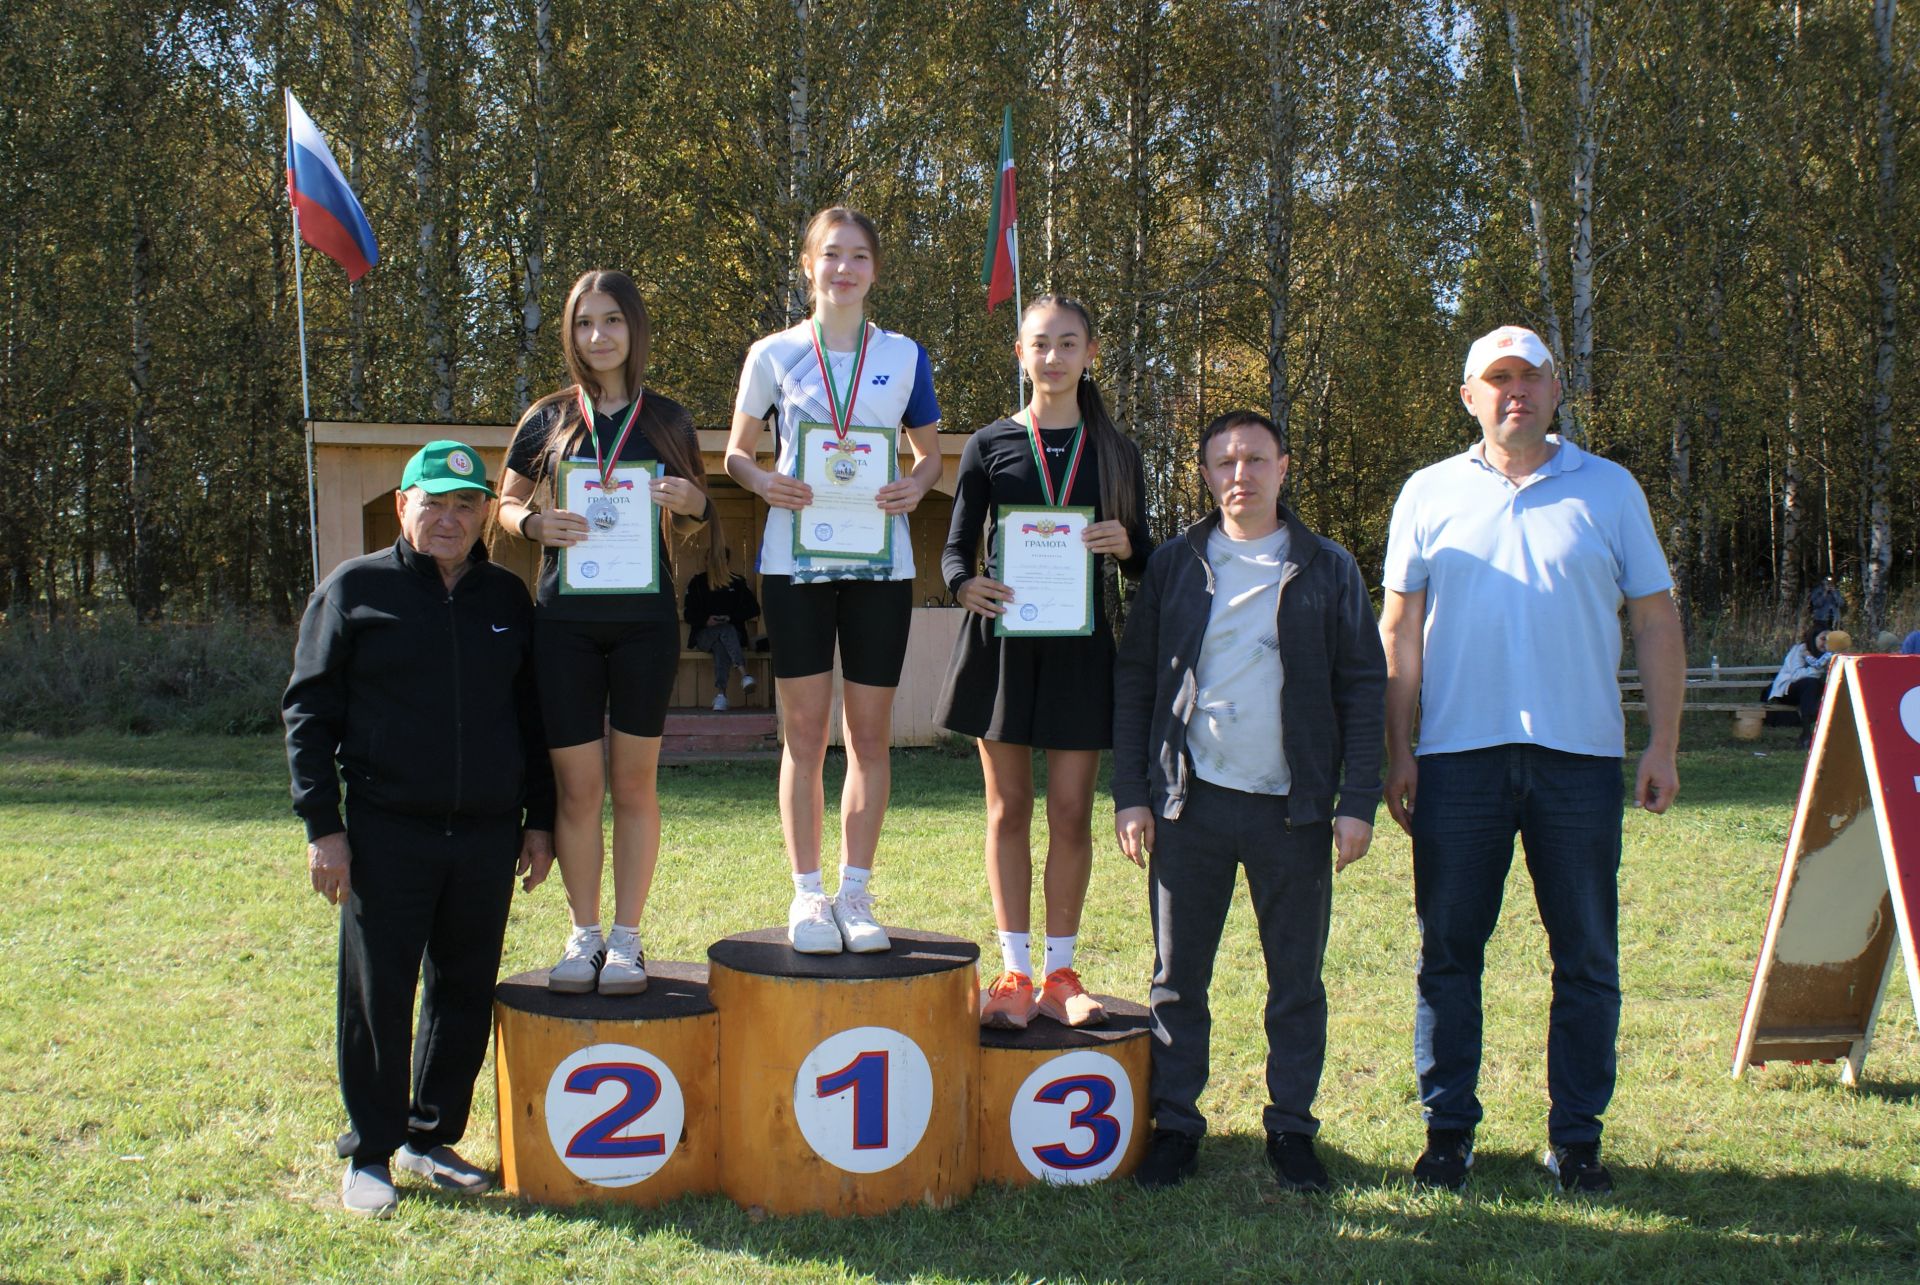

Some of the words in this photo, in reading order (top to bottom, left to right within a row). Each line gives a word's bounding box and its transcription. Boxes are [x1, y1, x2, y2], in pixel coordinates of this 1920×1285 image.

[1025, 540, 1067, 548] ГРАМОТА
[563, 1061, 667, 1159] 2
[816, 1050, 889, 1150] 1
[1032, 1074, 1121, 1171] 3
